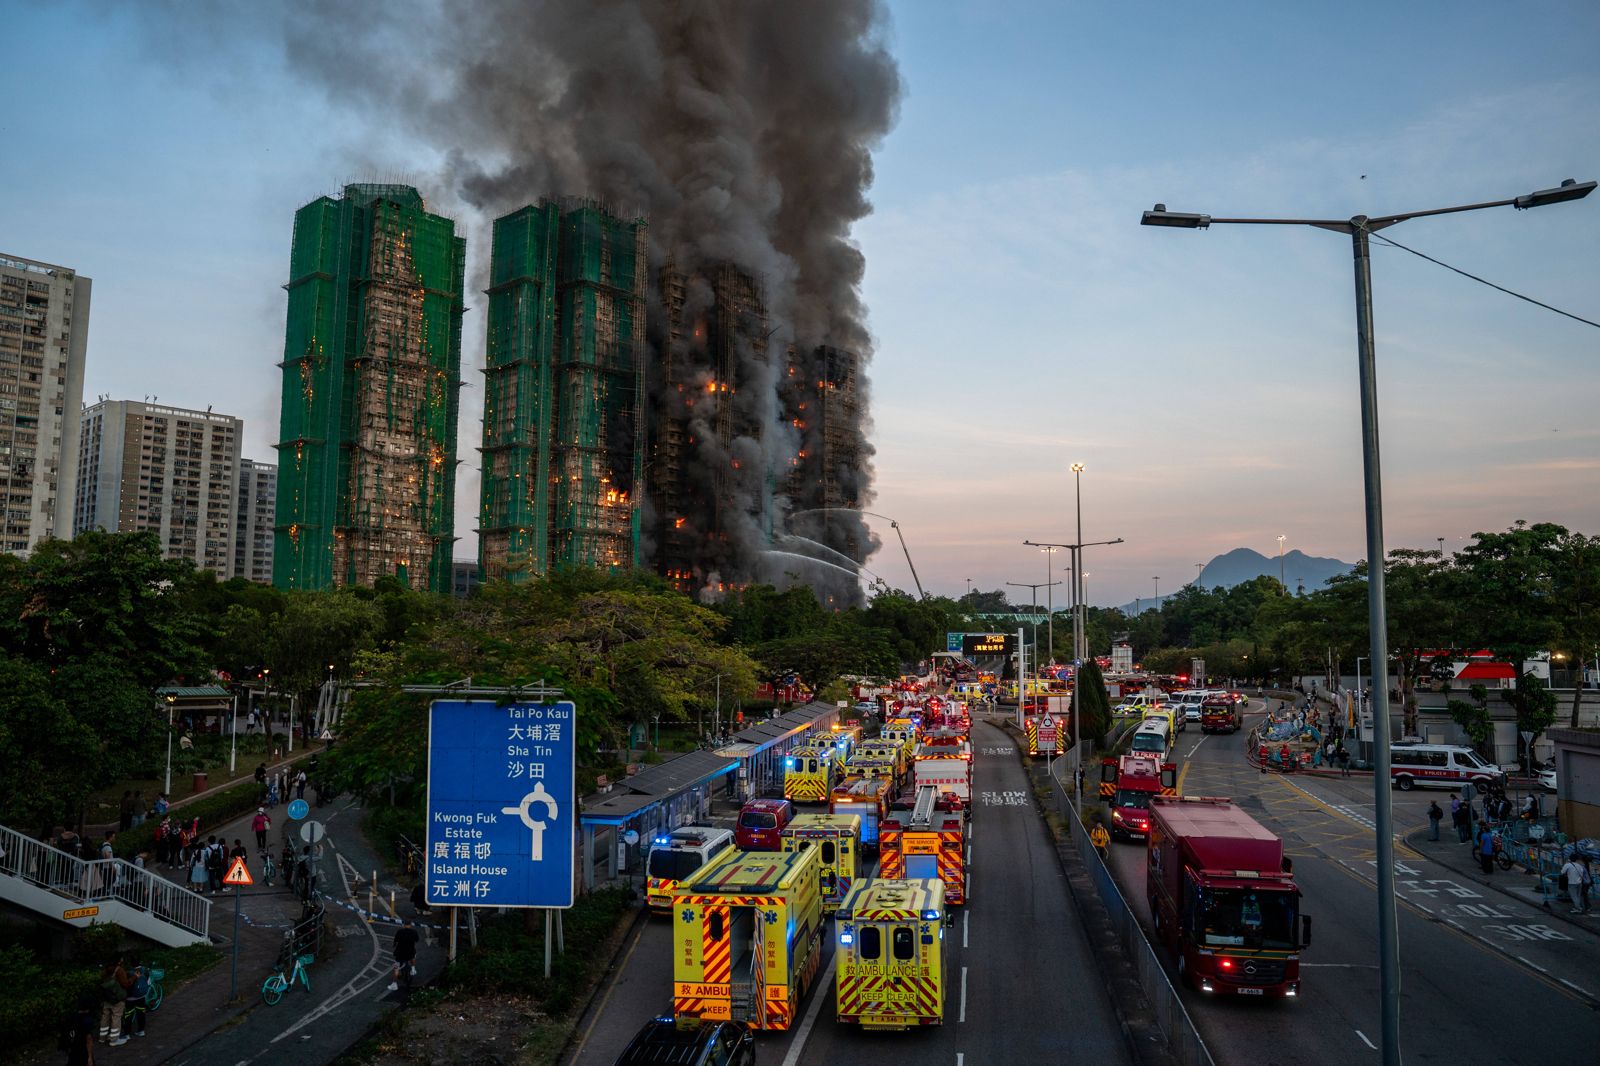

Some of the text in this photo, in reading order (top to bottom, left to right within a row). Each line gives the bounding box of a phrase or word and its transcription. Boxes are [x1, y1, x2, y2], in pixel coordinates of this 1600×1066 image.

[508, 708, 568, 719] Tai Po Kau
[508, 723, 561, 741] 大埔滘
[507, 745, 552, 756] Sha Tin
[507, 761, 544, 779] 沙田
[434, 811, 497, 825] Kwong Fuk
[445, 827, 483, 838] Estate
[433, 841, 491, 859] 廣福邨
[433, 864, 508, 875] Island House
[433, 880, 491, 897] 元洲仔
[1481, 924, 1574, 941] BUS
[846, 965, 855, 976] 救
[859, 965, 917, 976] AMBULANCE
[681, 985, 691, 995] 救
[861, 992, 915, 1001] KEEP CLEAR
[707, 1006, 727, 1014] KEEP
